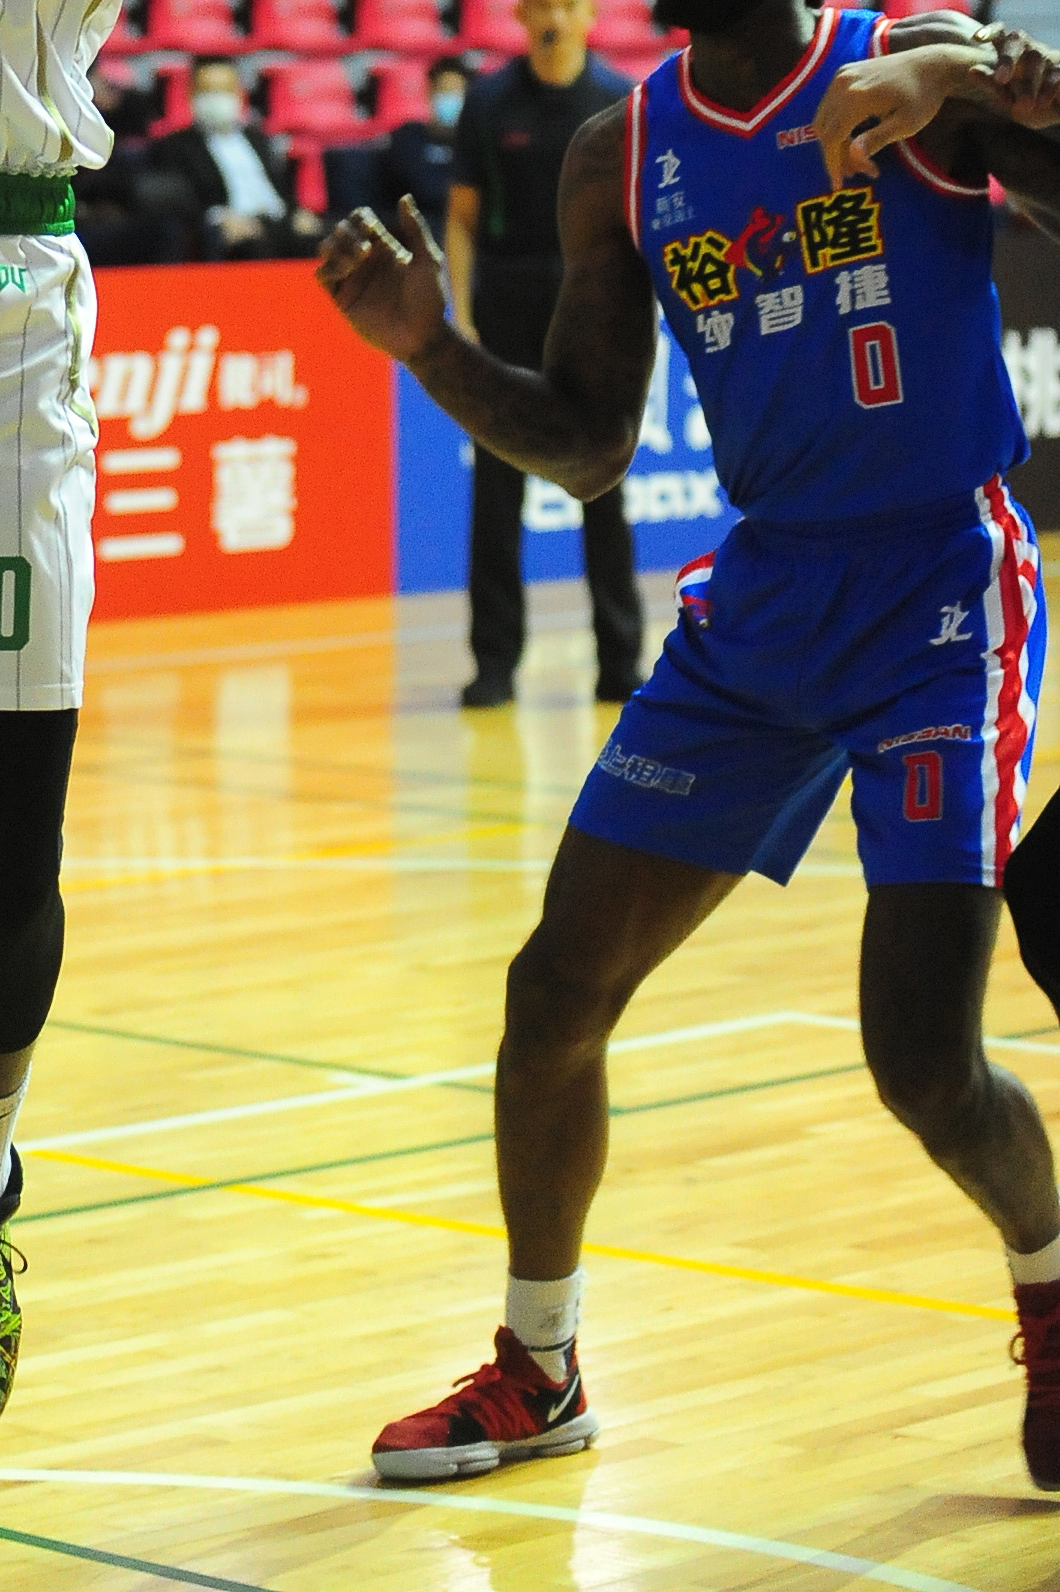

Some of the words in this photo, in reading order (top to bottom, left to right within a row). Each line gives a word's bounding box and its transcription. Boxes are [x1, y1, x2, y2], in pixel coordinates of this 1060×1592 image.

[90, 323, 221, 441] nji
[848, 320, 903, 409] 0
[902, 750, 943, 822] 0
